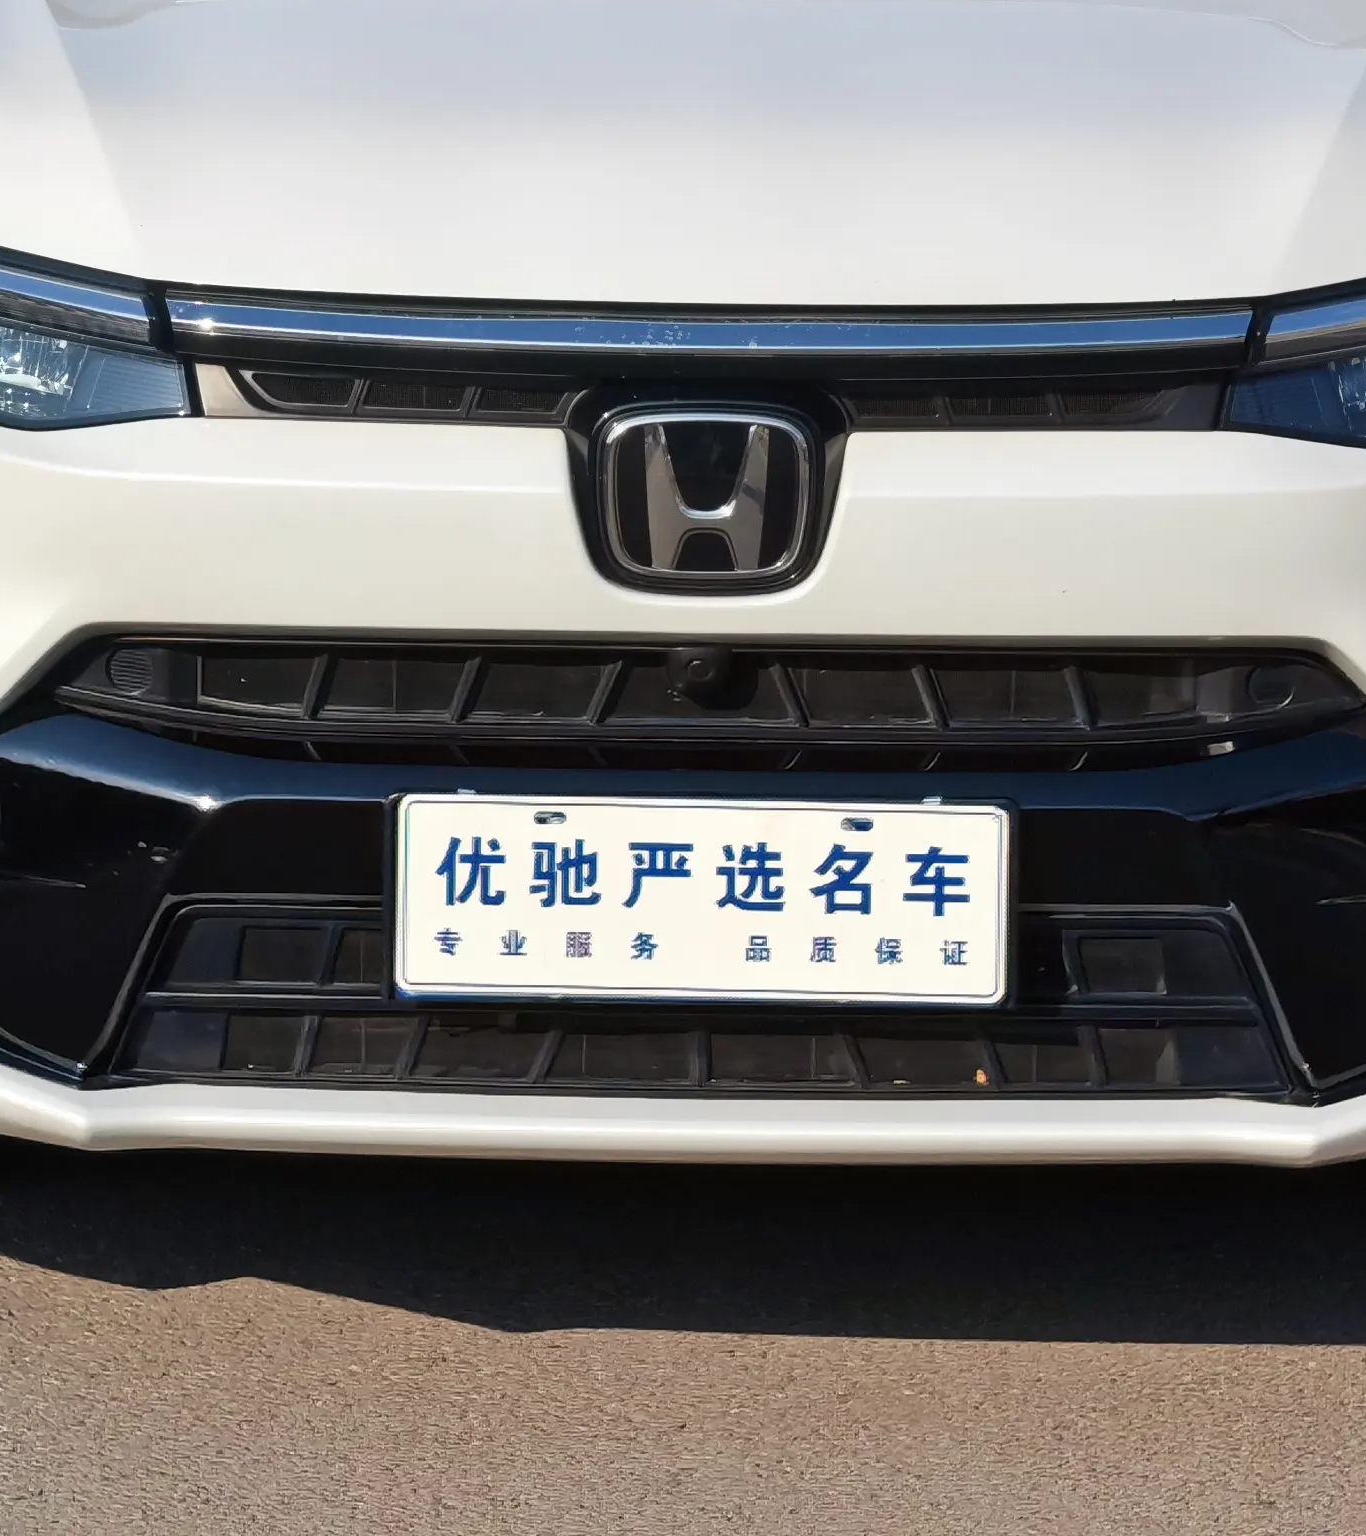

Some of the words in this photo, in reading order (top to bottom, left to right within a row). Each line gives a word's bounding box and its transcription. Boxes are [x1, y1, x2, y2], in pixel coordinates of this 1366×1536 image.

[435, 836, 971, 917] 优驰严选名车
[433, 927, 660, 961] 专业服务
[745, 934, 970, 966] 品质保证
